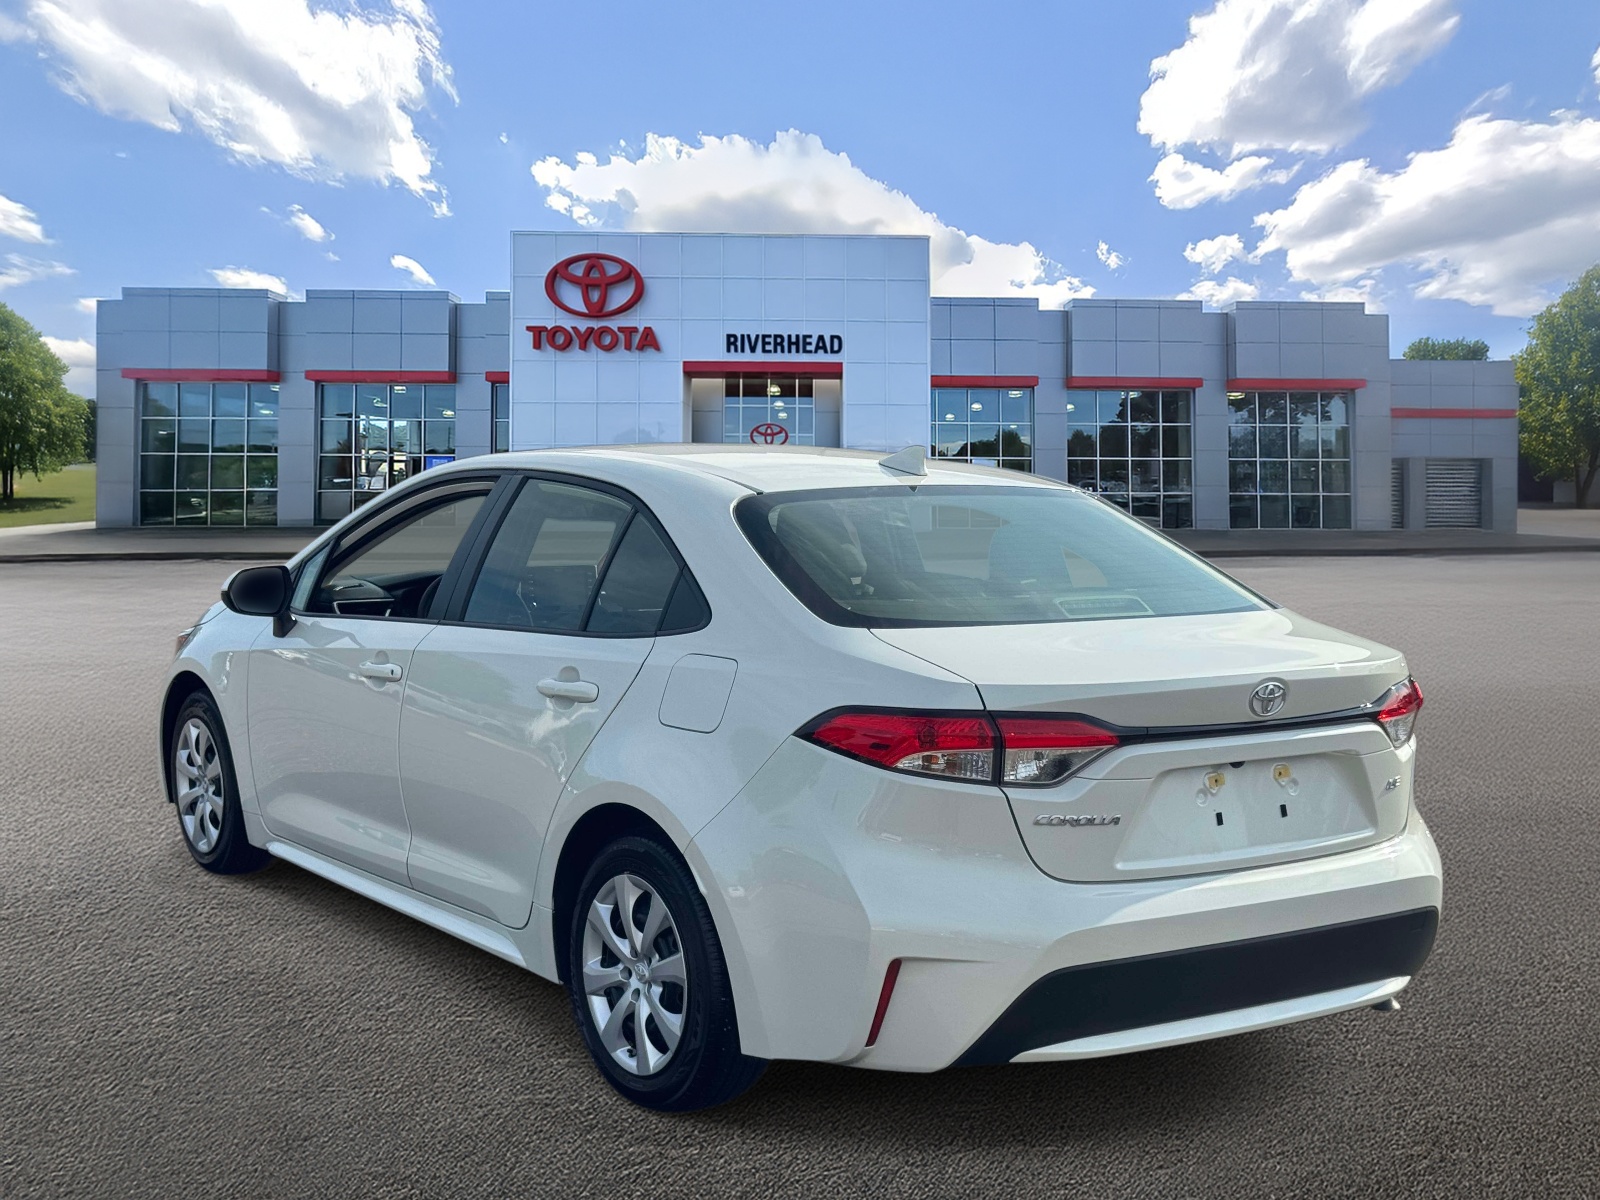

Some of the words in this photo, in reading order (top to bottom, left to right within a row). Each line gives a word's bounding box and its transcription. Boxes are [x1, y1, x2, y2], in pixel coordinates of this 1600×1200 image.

[525, 326, 661, 352] TOYOTA
[726, 333, 843, 354] RIVERHEAD
[1033, 814, 1121, 827] COROLLA
